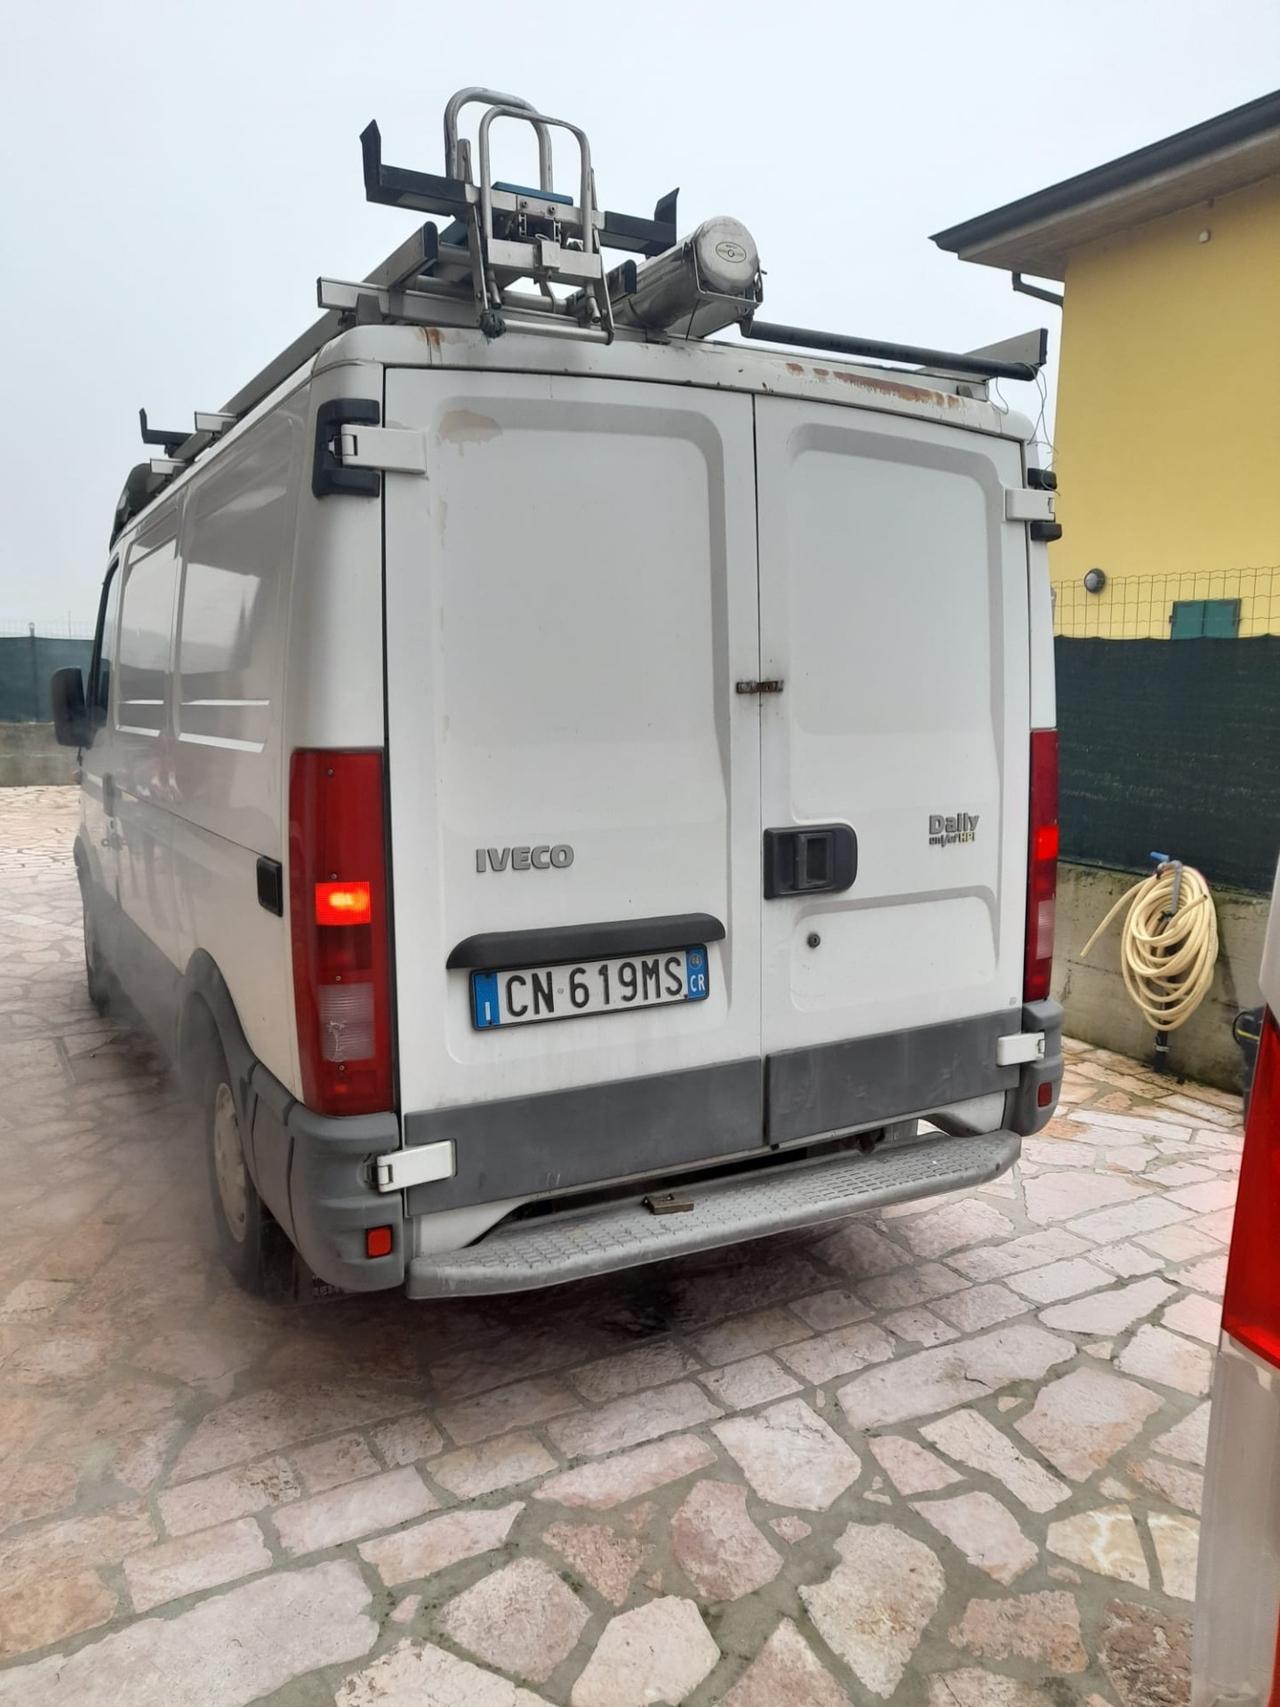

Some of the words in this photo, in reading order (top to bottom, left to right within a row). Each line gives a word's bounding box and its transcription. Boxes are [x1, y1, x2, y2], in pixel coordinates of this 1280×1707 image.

[929, 812, 980, 835] Daily
[476, 844, 575, 873] IVECO
[505, 971, 555, 1017] CN
[568, 956, 684, 1010] 619MS
[689, 974, 706, 993] CR
